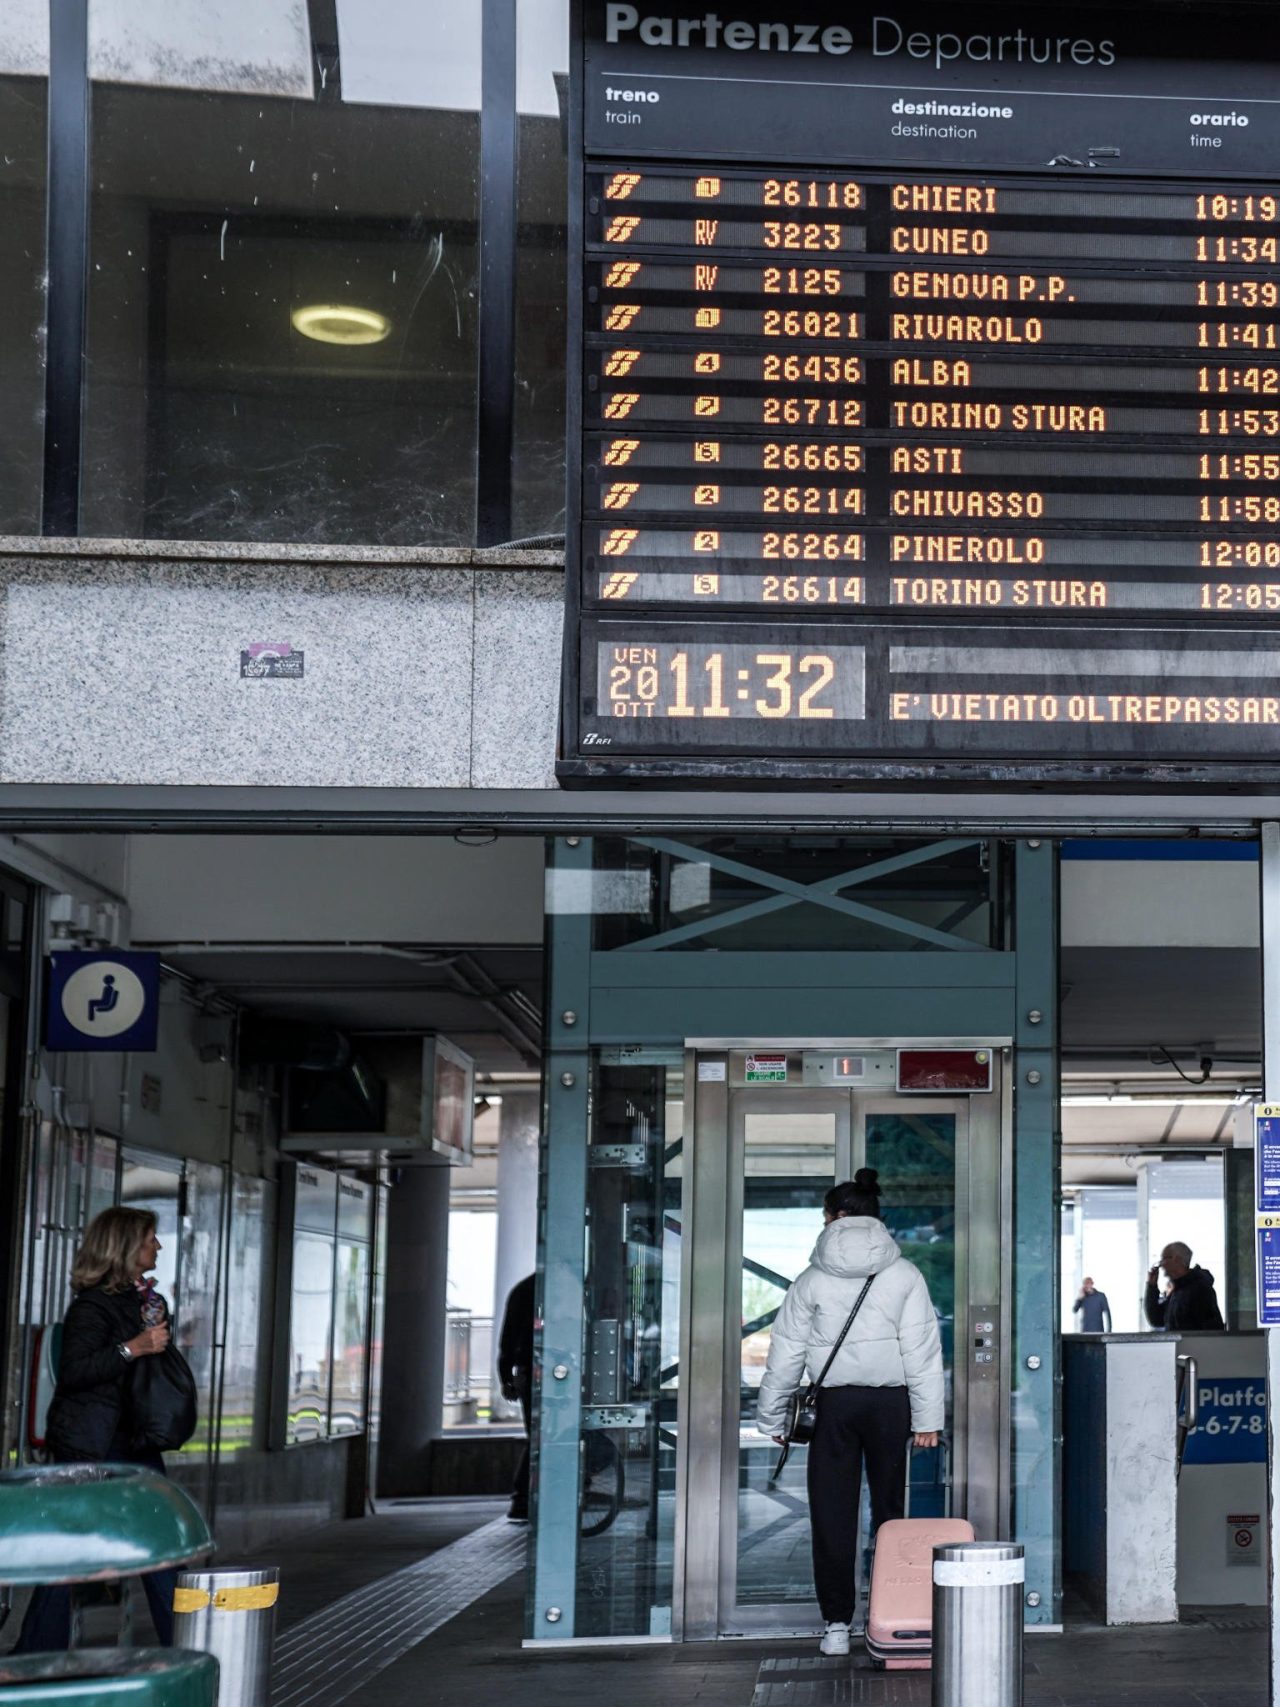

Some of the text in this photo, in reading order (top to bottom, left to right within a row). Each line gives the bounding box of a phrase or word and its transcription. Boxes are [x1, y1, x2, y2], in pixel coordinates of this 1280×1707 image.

[605, 4, 1116, 70] Partenze Departures
[605, 86, 660, 104] treno
[605, 109, 642, 125] train
[891, 100, 1013, 119] destinazione
[1189, 111, 1249, 127] orario
[891, 122, 978, 139] destination
[1190, 133, 1222, 148] time
[764, 180, 860, 208] 26118
[893, 184, 996, 214] CHIERI
[1196, 194, 1276, 222] 10:19
[695, 219, 718, 246] RV
[764, 221, 841, 250] 3223
[893, 226, 988, 256] CUNEO
[1196, 236, 1277, 264] 11:34
[695, 265, 718, 291] RV
[764, 267, 841, 295] 2125
[893, 271, 1075, 302] GENOVA P.P.
[1197, 280, 1277, 308] 11:39
[764, 310, 858, 338] 26021
[893, 313, 1042, 344] RIVAROLO
[1198, 322, 1276, 349] 11:41
[763, 355, 861, 383] 26436
[893, 358, 970, 386] ALBA
[1199, 367, 1279, 394] 11:42
[763, 398, 861, 426] 26712
[894, 401, 1105, 432] TORINO STURA
[1199, 409, 1279, 436] 11:53
[763, 444, 861, 472] 26665
[893, 446, 962, 474] ASTI
[1199, 454, 1280, 481] 11:55
[763, 486, 861, 514] 26214
[893, 489, 1043, 518] CHIVASSO
[1200, 496, 1280, 523] 11:58
[762, 532, 861, 560] 26264
[893, 535, 1044, 564] PINEROLO
[1200, 540, 1280, 569] 12:00
[762, 575, 862, 603] 26614
[893, 577, 1107, 608] TORINO STURA
[1200, 582, 1280, 611] 12:05
[615, 648, 656, 664] VEN
[610, 666, 659, 700] 20
[668, 653, 834, 718] 11:32
[614, 702, 655, 717] OTT
[893, 693, 921, 719] E'
[931, 694, 1057, 721] VIETATO
[842, 1059, 849, 1075] 1
[1200, 1385, 1266, 1407] Platfo
